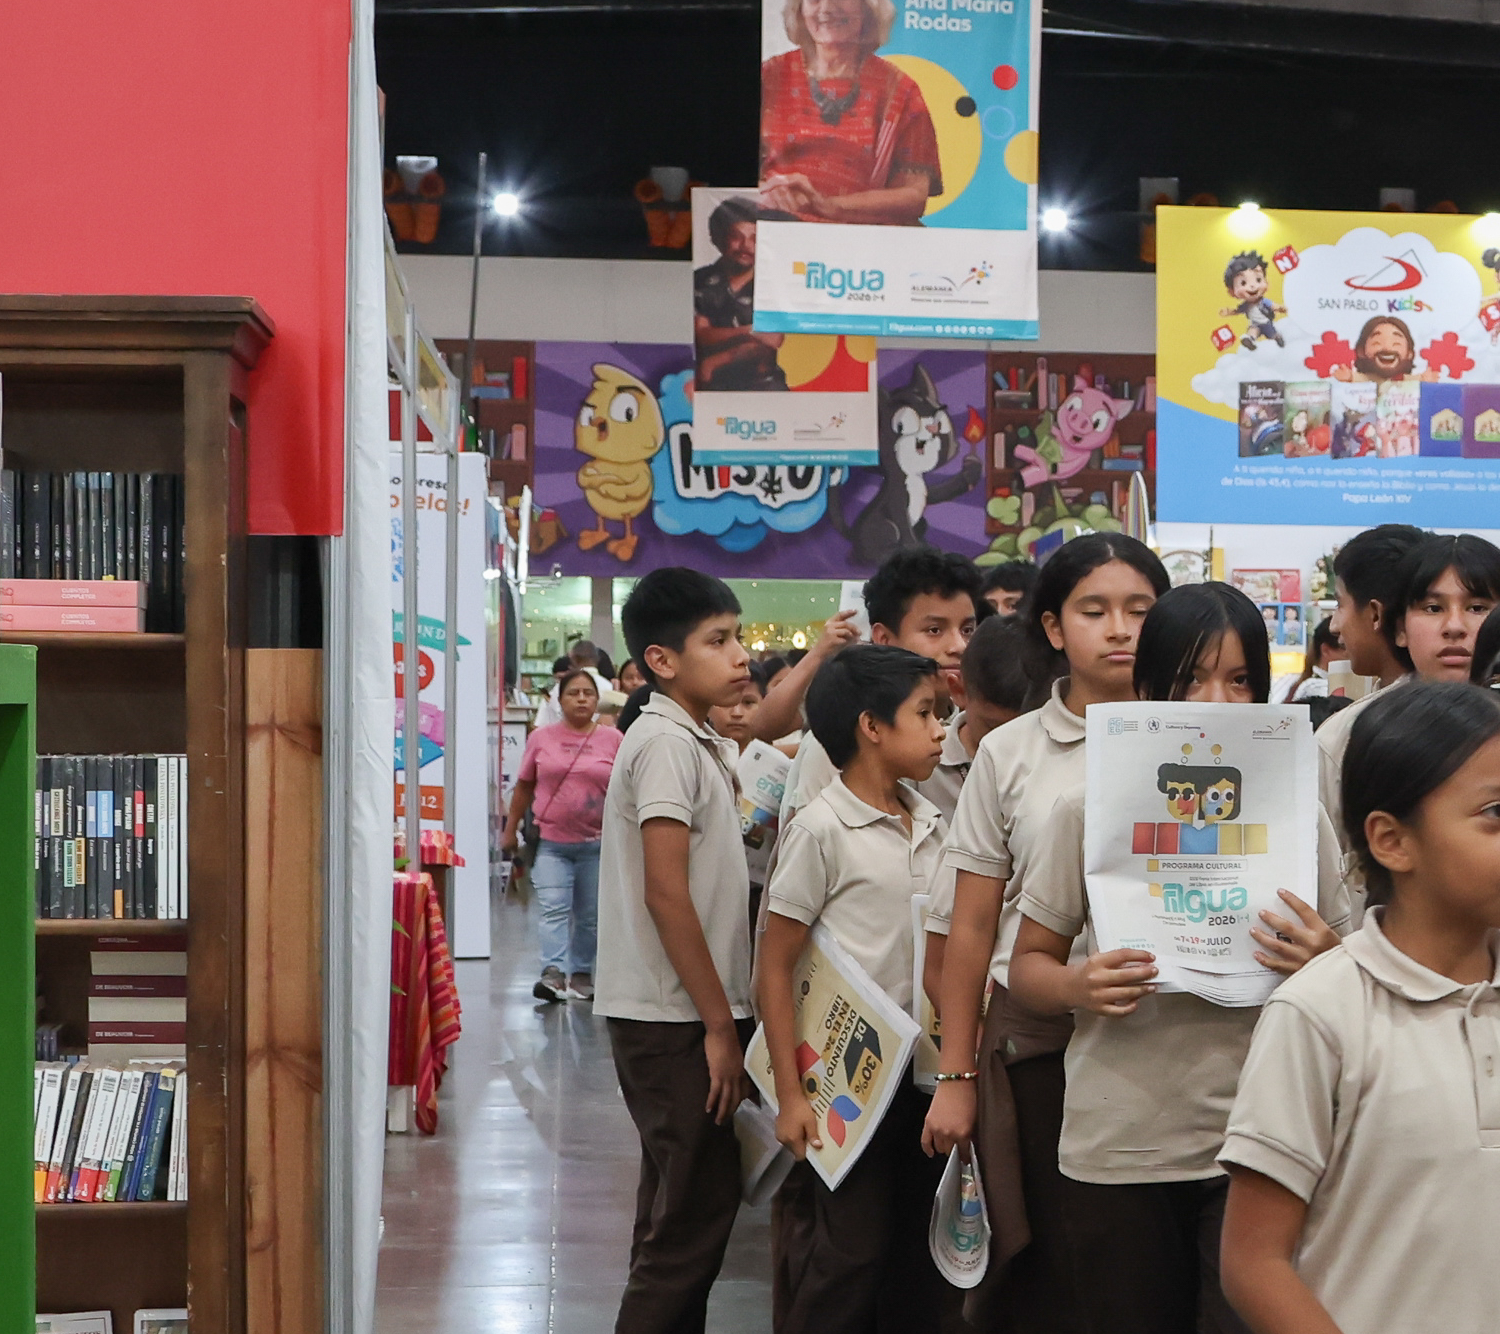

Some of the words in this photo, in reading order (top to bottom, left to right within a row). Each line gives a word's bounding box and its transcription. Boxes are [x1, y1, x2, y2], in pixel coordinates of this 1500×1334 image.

[905, 11, 973, 33] Rodas
[806, 262, 884, 298] filgua
[1318, 298, 1341, 310] SAN
[1343, 299, 1379, 310] PABLO
[1387, 295, 1433, 312] Kids
[1161, 862, 1204, 870] PROGRAMA
[1205, 862, 1242, 870] CULTURAL
[1163, 883, 1248, 923] filgua
[1208, 916, 1236, 926] 2026
[1206, 936, 1232, 946] JULIO
[825, 994, 843, 1030] LIBRO
[853, 1019, 867, 1043] DE
[826, 1009, 857, 1078] DESCUENTO
[854, 1055, 877, 1095] 30%
